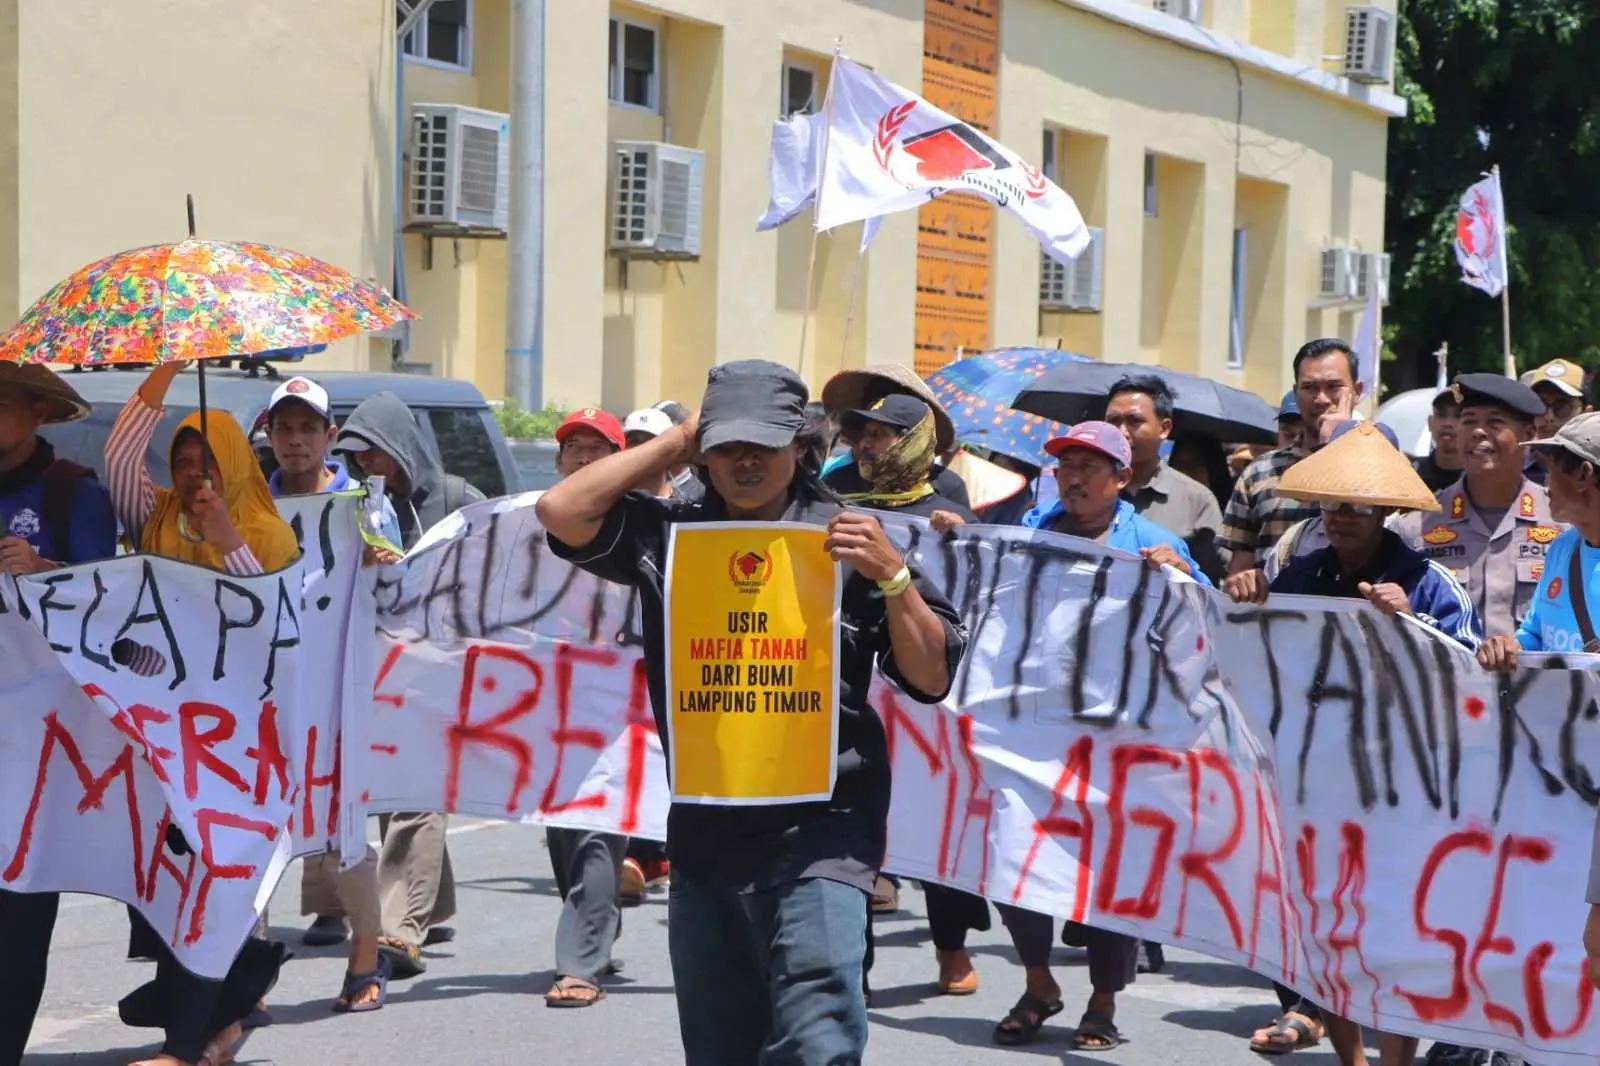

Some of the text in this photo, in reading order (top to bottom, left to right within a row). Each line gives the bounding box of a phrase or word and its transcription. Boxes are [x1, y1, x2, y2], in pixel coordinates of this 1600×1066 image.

[727, 611, 768, 633] USIR
[690, 638, 807, 660] MAFIA TANAH
[701, 664, 793, 686] DARI BUMI
[679, 691, 822, 713] LAMPUNG TIMUR
[1227, 609, 1462, 820] TANI
